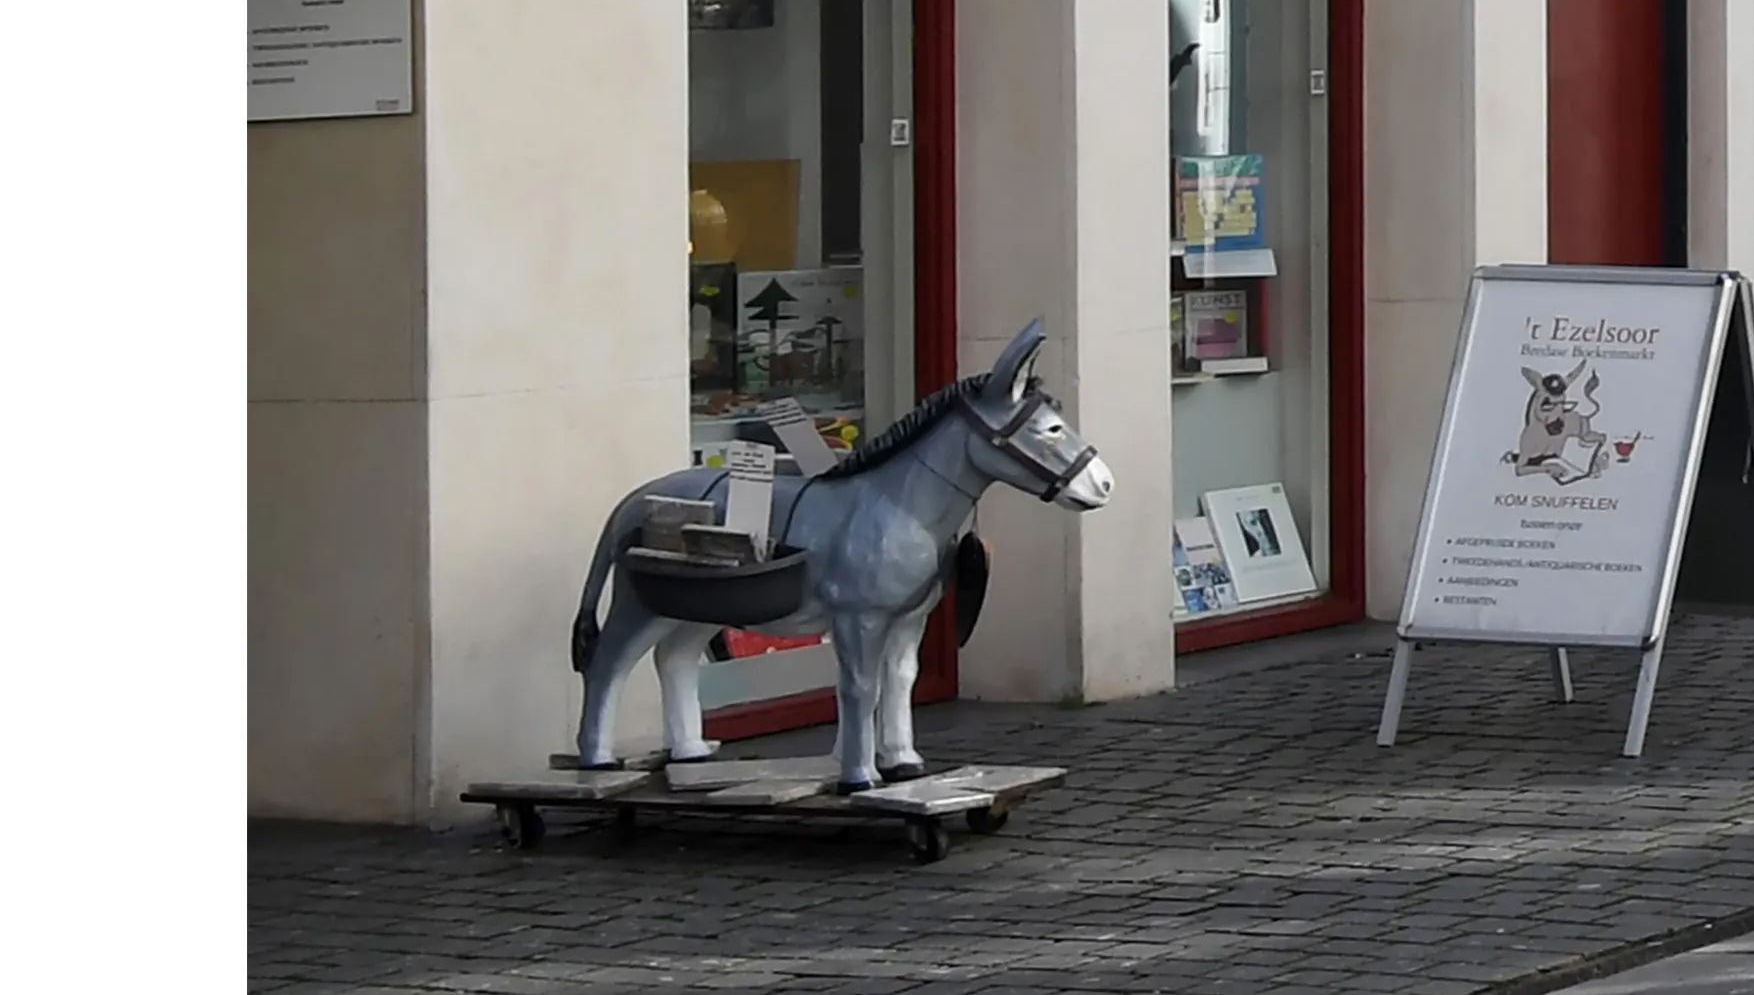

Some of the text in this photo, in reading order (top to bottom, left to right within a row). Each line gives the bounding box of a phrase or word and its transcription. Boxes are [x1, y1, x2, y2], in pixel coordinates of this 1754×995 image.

[1550, 316, 1660, 344] Ezelsoor
[1494, 493, 1619, 511] KOM SNUFFELEN
[1517, 539, 1556, 550] BOEKEN
[1604, 562, 1643, 573] BOEKEN
